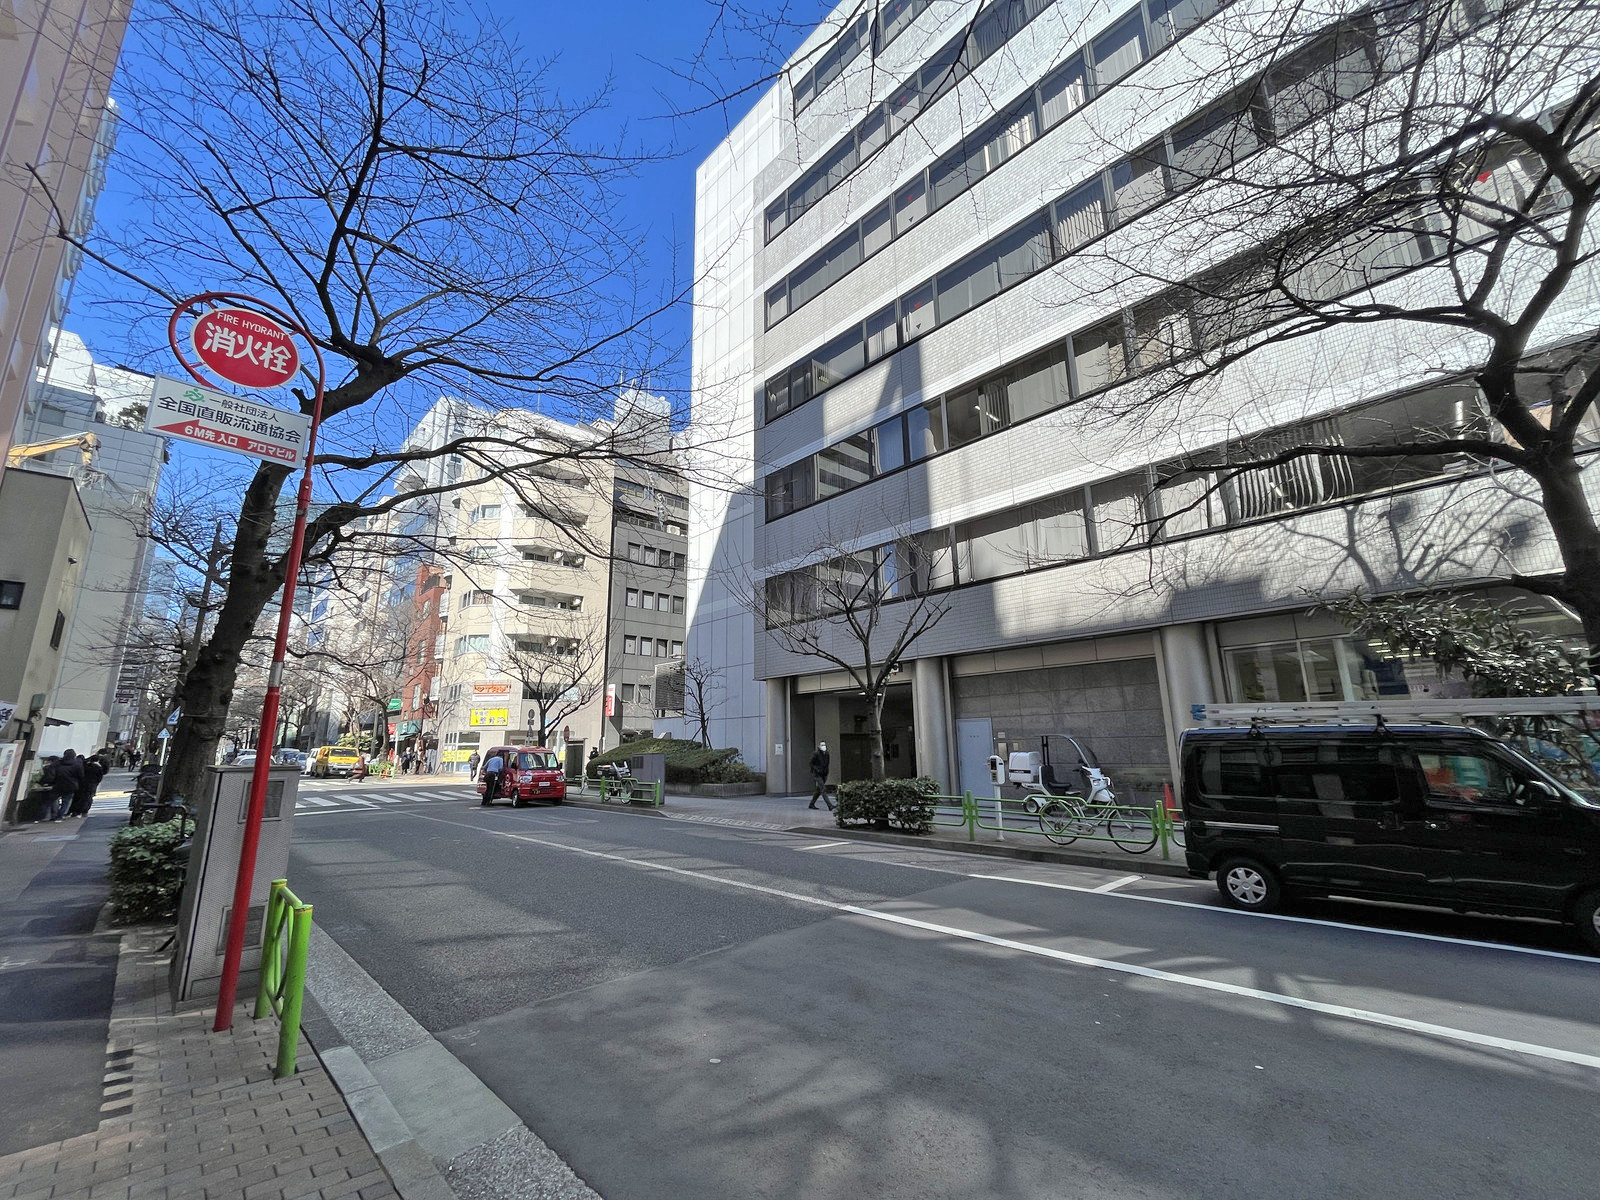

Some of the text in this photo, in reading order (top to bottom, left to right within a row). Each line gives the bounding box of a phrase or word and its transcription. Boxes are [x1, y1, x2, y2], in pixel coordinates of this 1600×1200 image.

[217, 312, 286, 341] FIRE HYDRANT
[202, 322, 293, 375] 消火栓
[157, 396, 302, 444] 全国直販流通協会
[209, 398, 280, 423] 一般社団法人
[217, 434, 239, 446] 入口
[247, 441, 296, 460] アロマビル
